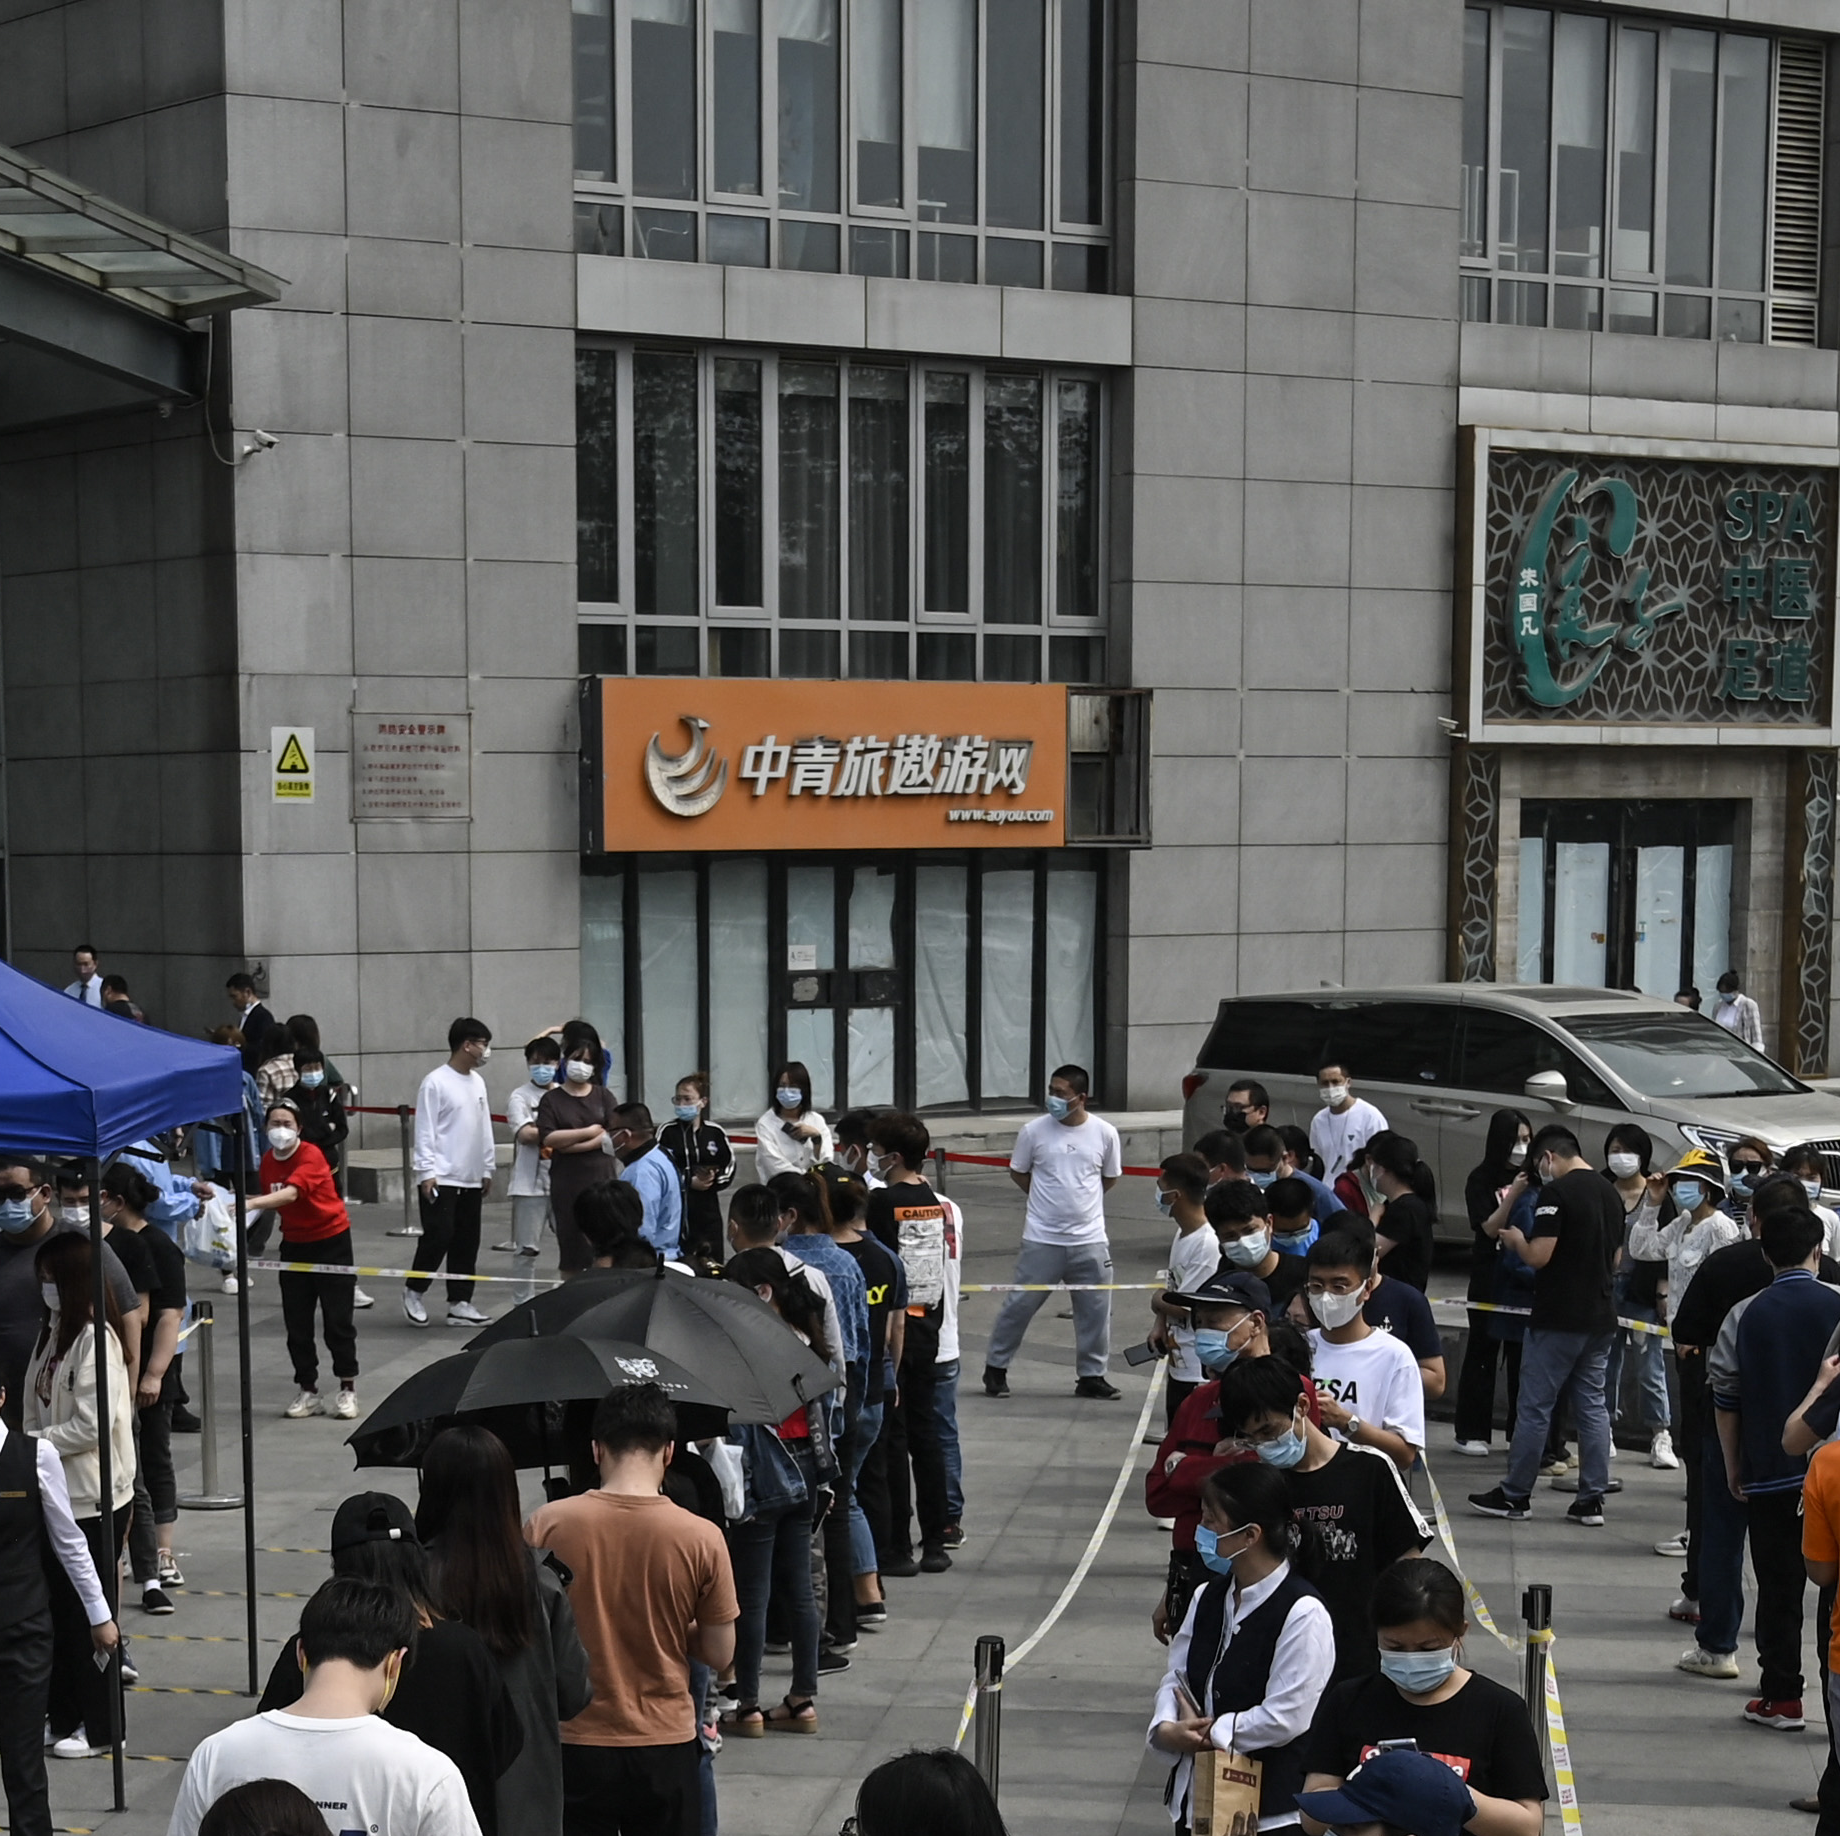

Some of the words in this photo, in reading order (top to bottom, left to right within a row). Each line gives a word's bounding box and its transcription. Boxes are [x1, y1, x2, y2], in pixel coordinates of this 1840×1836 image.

[1723, 487, 1815, 543] SPA
[1721, 554, 1814, 622] 中医
[1717, 638, 1812, 703] 足道
[737, 732, 1034, 800] 中青旅遨游网
[946, 806, 1055, 827] www.aoyou.com
